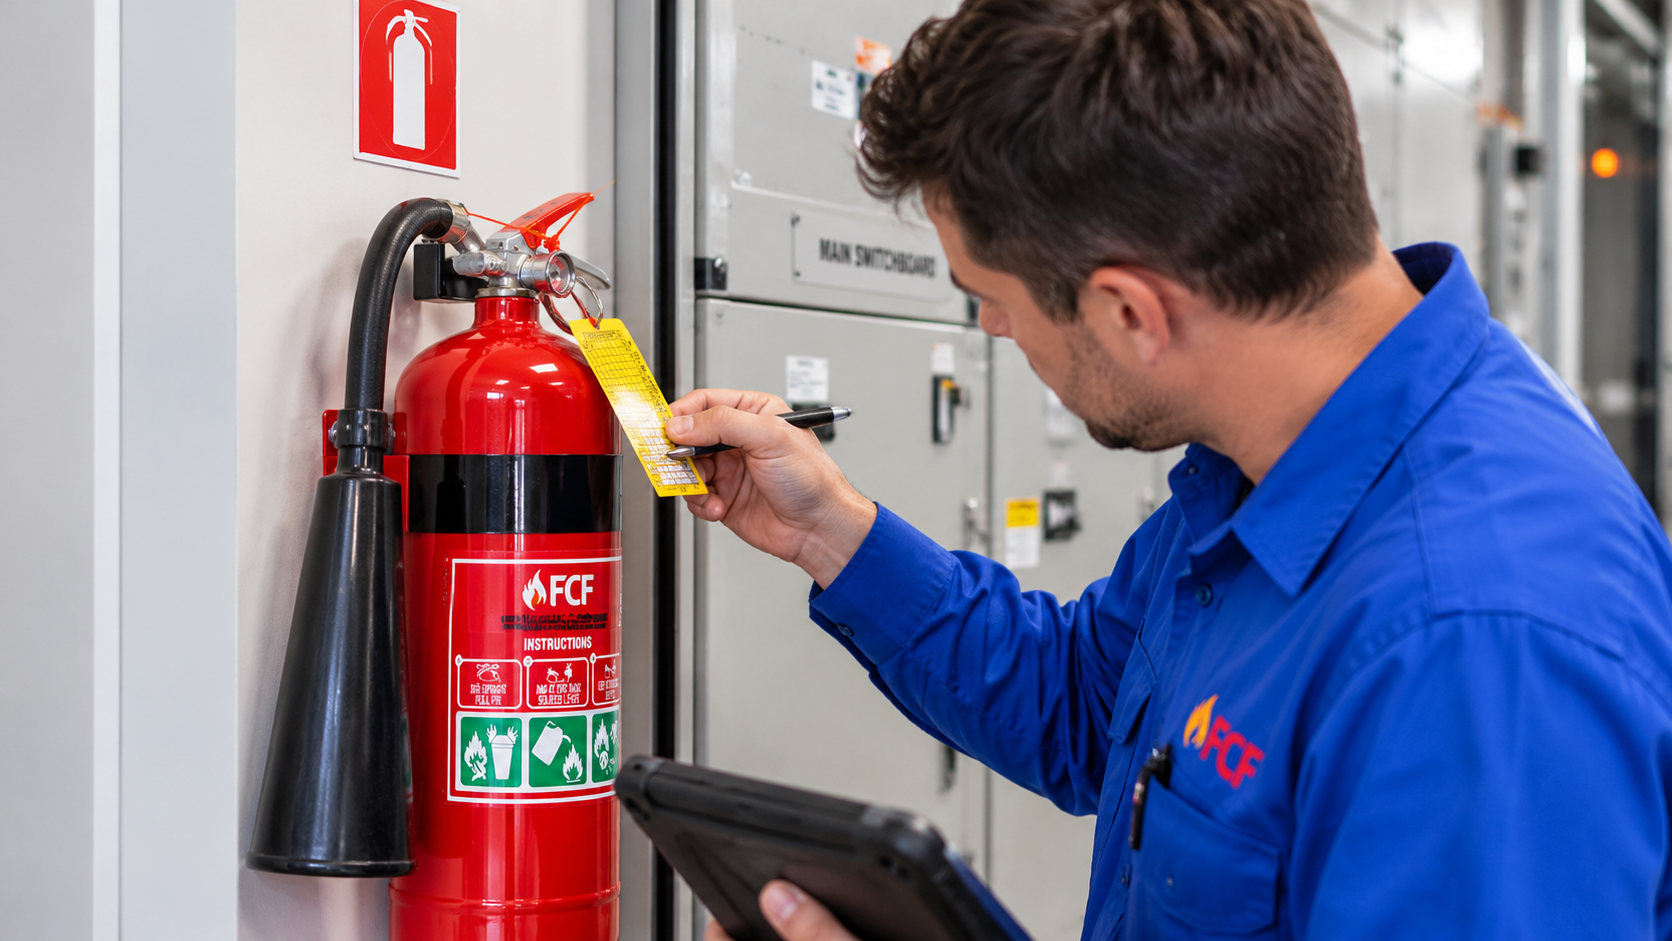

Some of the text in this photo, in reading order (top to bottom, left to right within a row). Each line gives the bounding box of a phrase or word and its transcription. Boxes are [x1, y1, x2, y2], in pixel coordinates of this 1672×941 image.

[819, 237, 937, 279] MAIN SWITCHBOARD
[550, 574, 594, 607] FCF
[524, 636, 592, 651] INSTRUCTIONS
[1199, 714, 1265, 790] FCF
